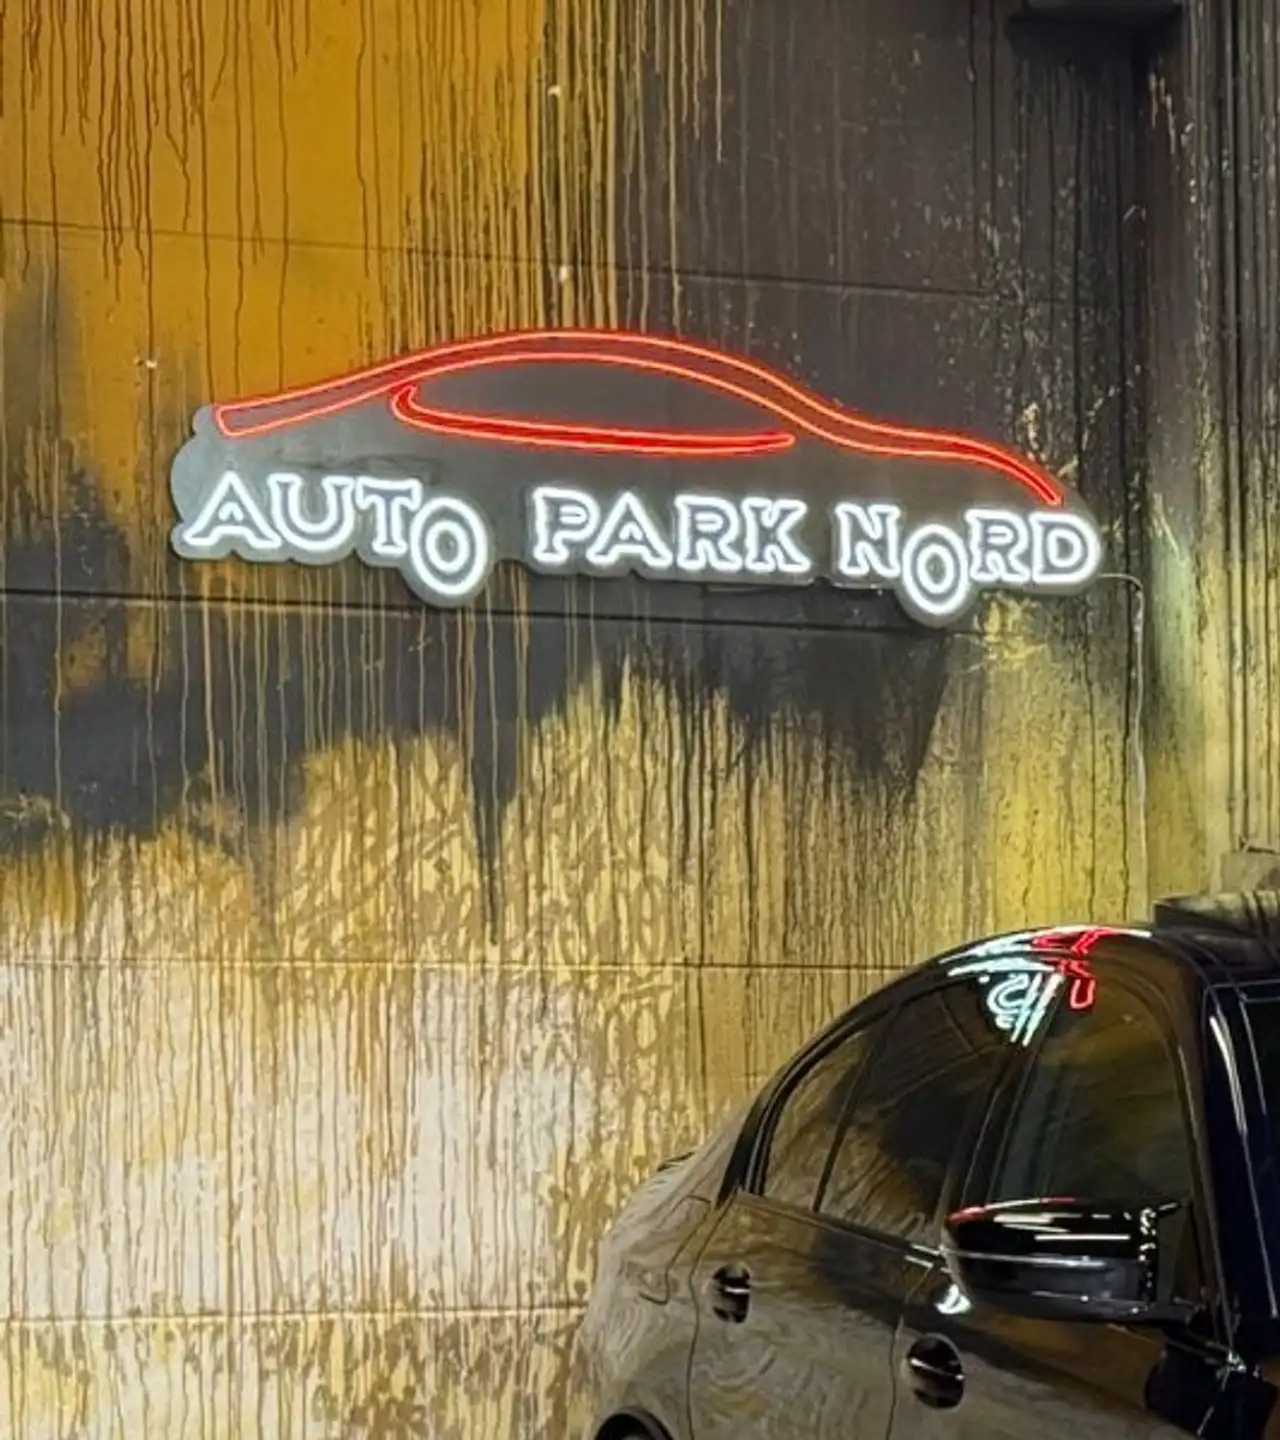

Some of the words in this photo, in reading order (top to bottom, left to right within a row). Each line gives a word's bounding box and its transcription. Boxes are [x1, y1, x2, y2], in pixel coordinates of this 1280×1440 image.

[184, 471, 487, 596] AUTO
[531, 486, 807, 573] PARK
[834, 502, 1100, 617] NORD
